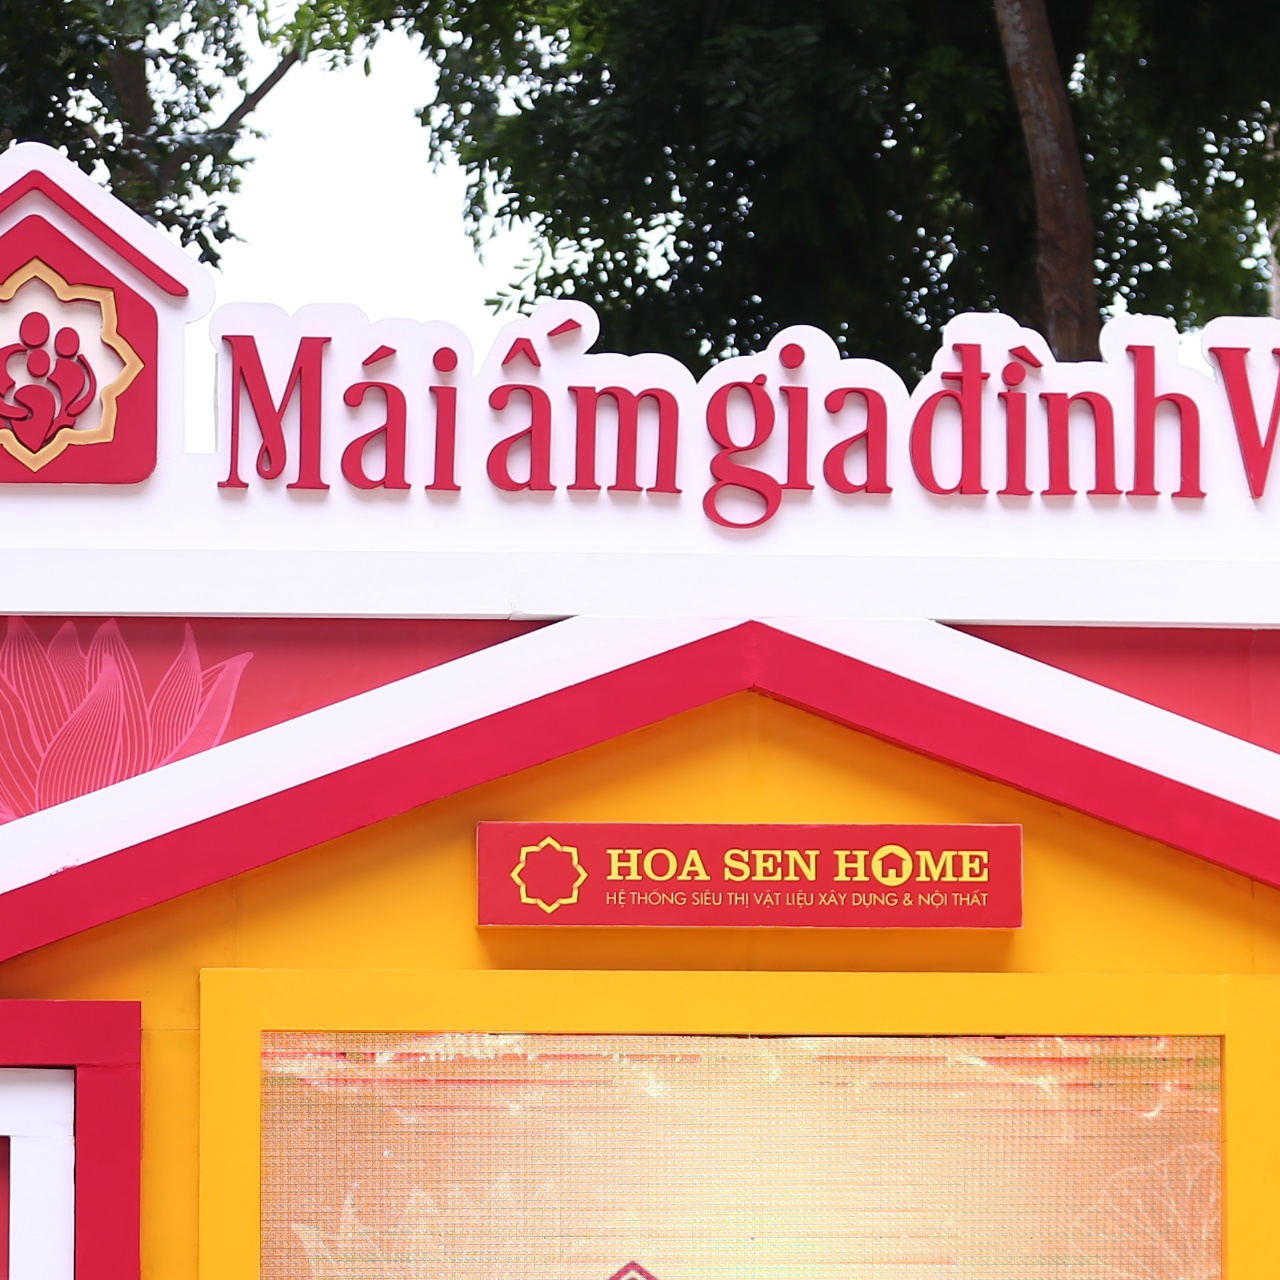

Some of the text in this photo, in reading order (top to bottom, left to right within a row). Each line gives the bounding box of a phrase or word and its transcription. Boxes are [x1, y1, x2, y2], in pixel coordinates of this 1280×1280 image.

[217, 335, 461, 491] Mái
[486, 318, 682, 494] ấm
[702, 343, 893, 528] gia
[908, 343, 1207, 498] đình
[606, 848, 711, 882] HOA
[724, 848, 821, 882] SEN
[606, 889, 626, 908] HỆ
[630, 888, 687, 906] THỐNG
[692, 889, 723, 906] SIÊU
[727, 891, 749, 909] THỊ
[753, 889, 781, 909] VẬT
[786, 889, 814, 909] LIỆU
[819, 889, 847, 906] XÂY
[903, 892, 914, 906] &
[918, 889, 948, 909] NỘI
[952, 888, 989, 907] THẤT
